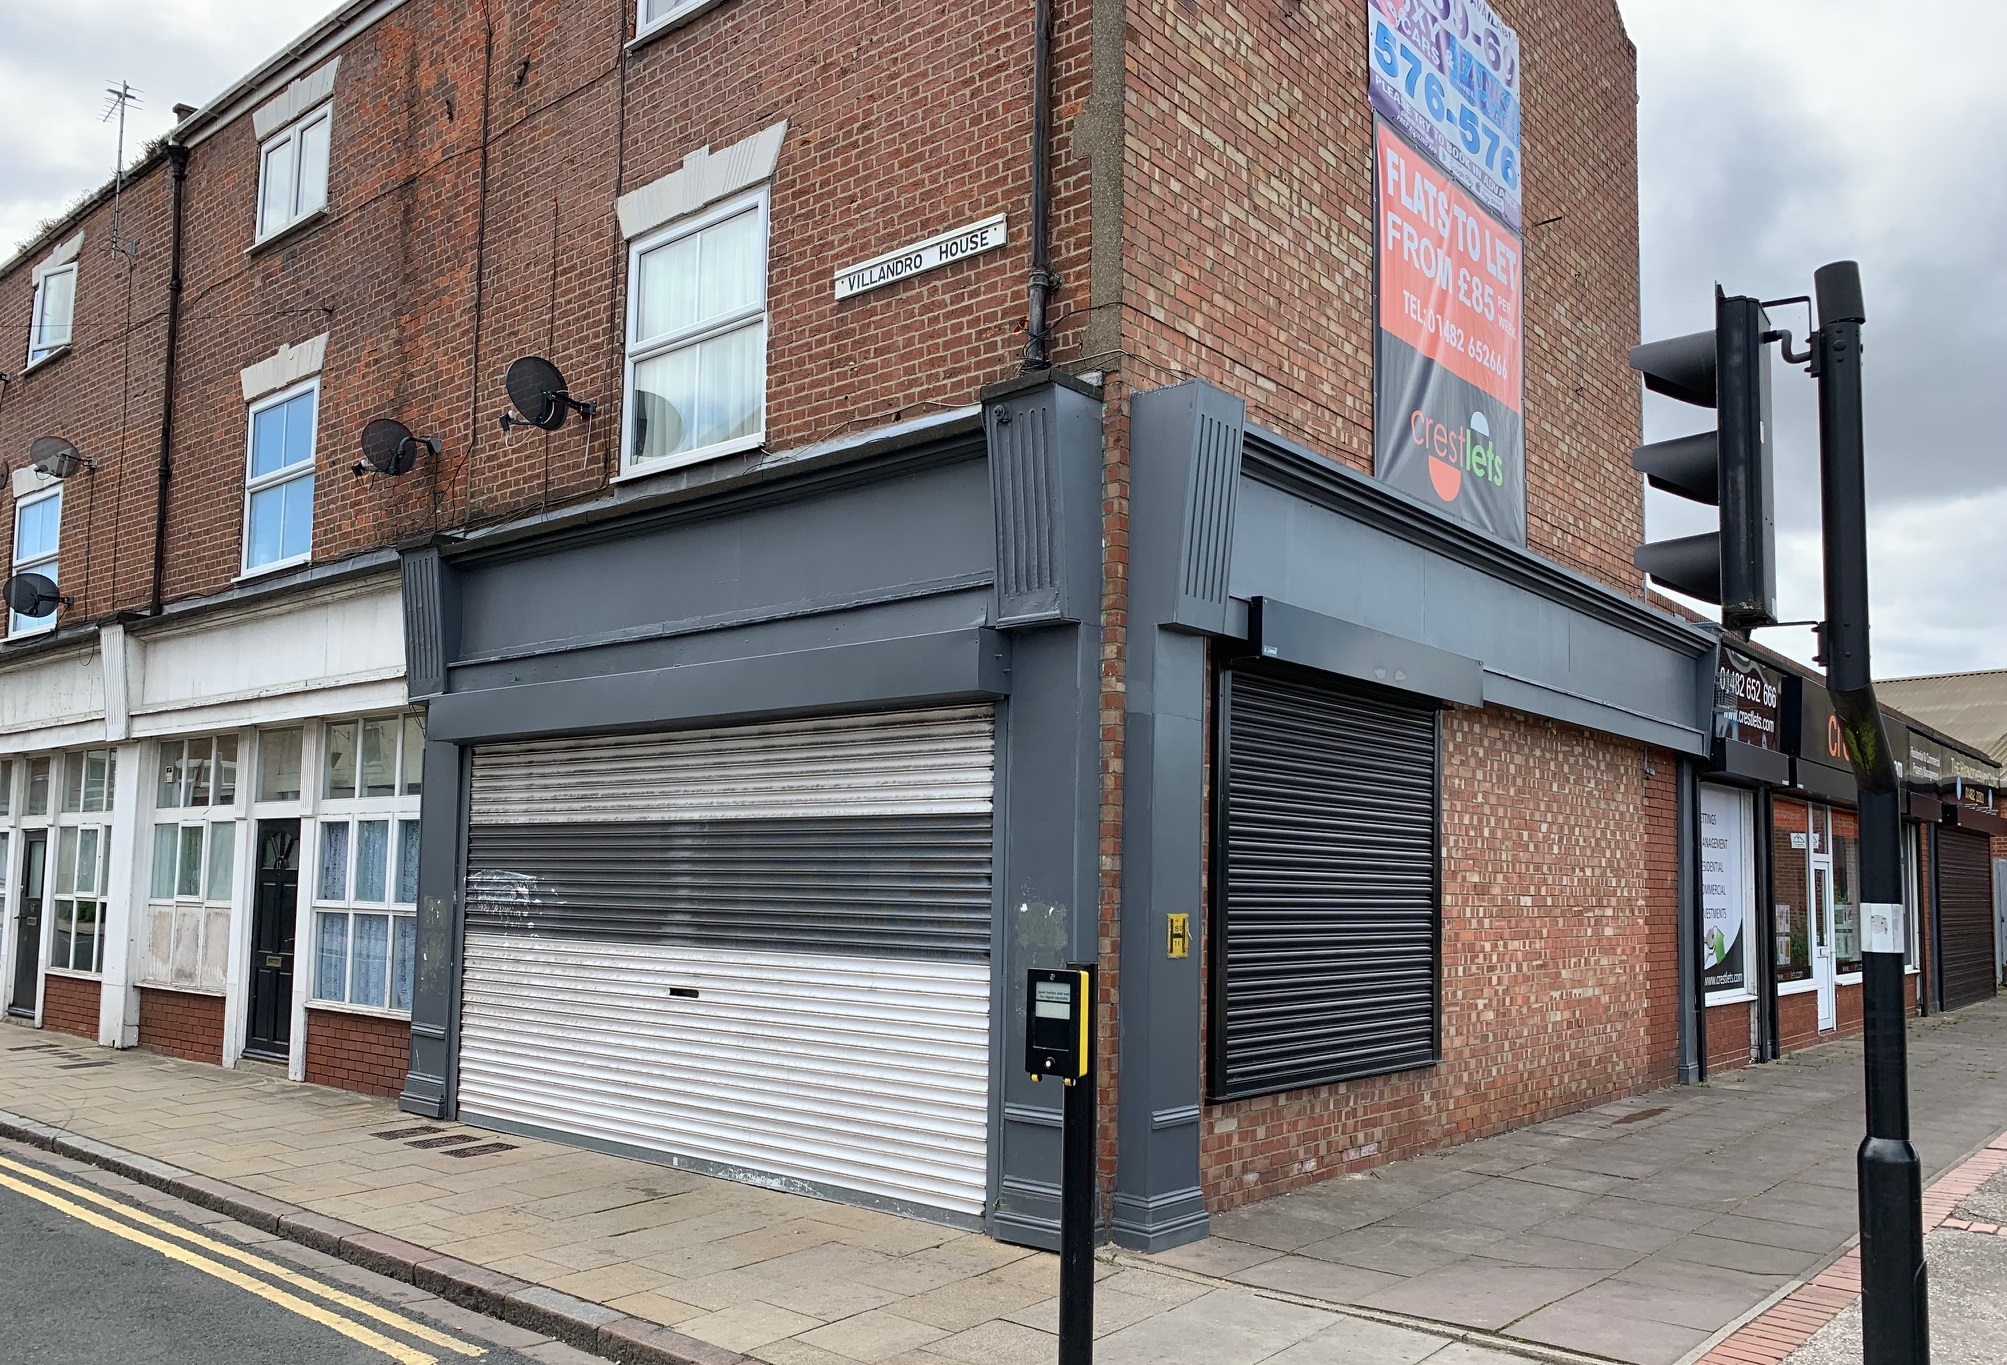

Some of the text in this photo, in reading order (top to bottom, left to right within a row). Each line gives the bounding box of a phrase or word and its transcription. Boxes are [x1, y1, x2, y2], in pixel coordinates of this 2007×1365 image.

[1401, 17, 1440, 66] CARS
[1374, 20, 1517, 191] 576-576
[1375, 73, 1413, 116] PLEASE
[1413, 109, 1432, 133] TRY
[1433, 127, 1445, 146] TO
[1446, 143, 1471, 170] BOOK
[1472, 162, 1482, 179] IN
[1483, 176, 1519, 213] ADVANCE
[1386, 147, 1517, 292] FLATS TO LET
[848, 229, 989, 292] VILLANDRO HOUSE
[1387, 210, 1495, 322] FROM £85
[1497, 295, 1511, 317] PER
[1497, 314, 1516, 341] WEEK
[1403, 289, 1508, 380] TEL: 01482 652666
[1719, 666, 1777, 709] 01482 652 666
[1723, 708, 1775, 734] www.crestlets.com
[1704, 971, 1743, 986] www.crestlets.com
